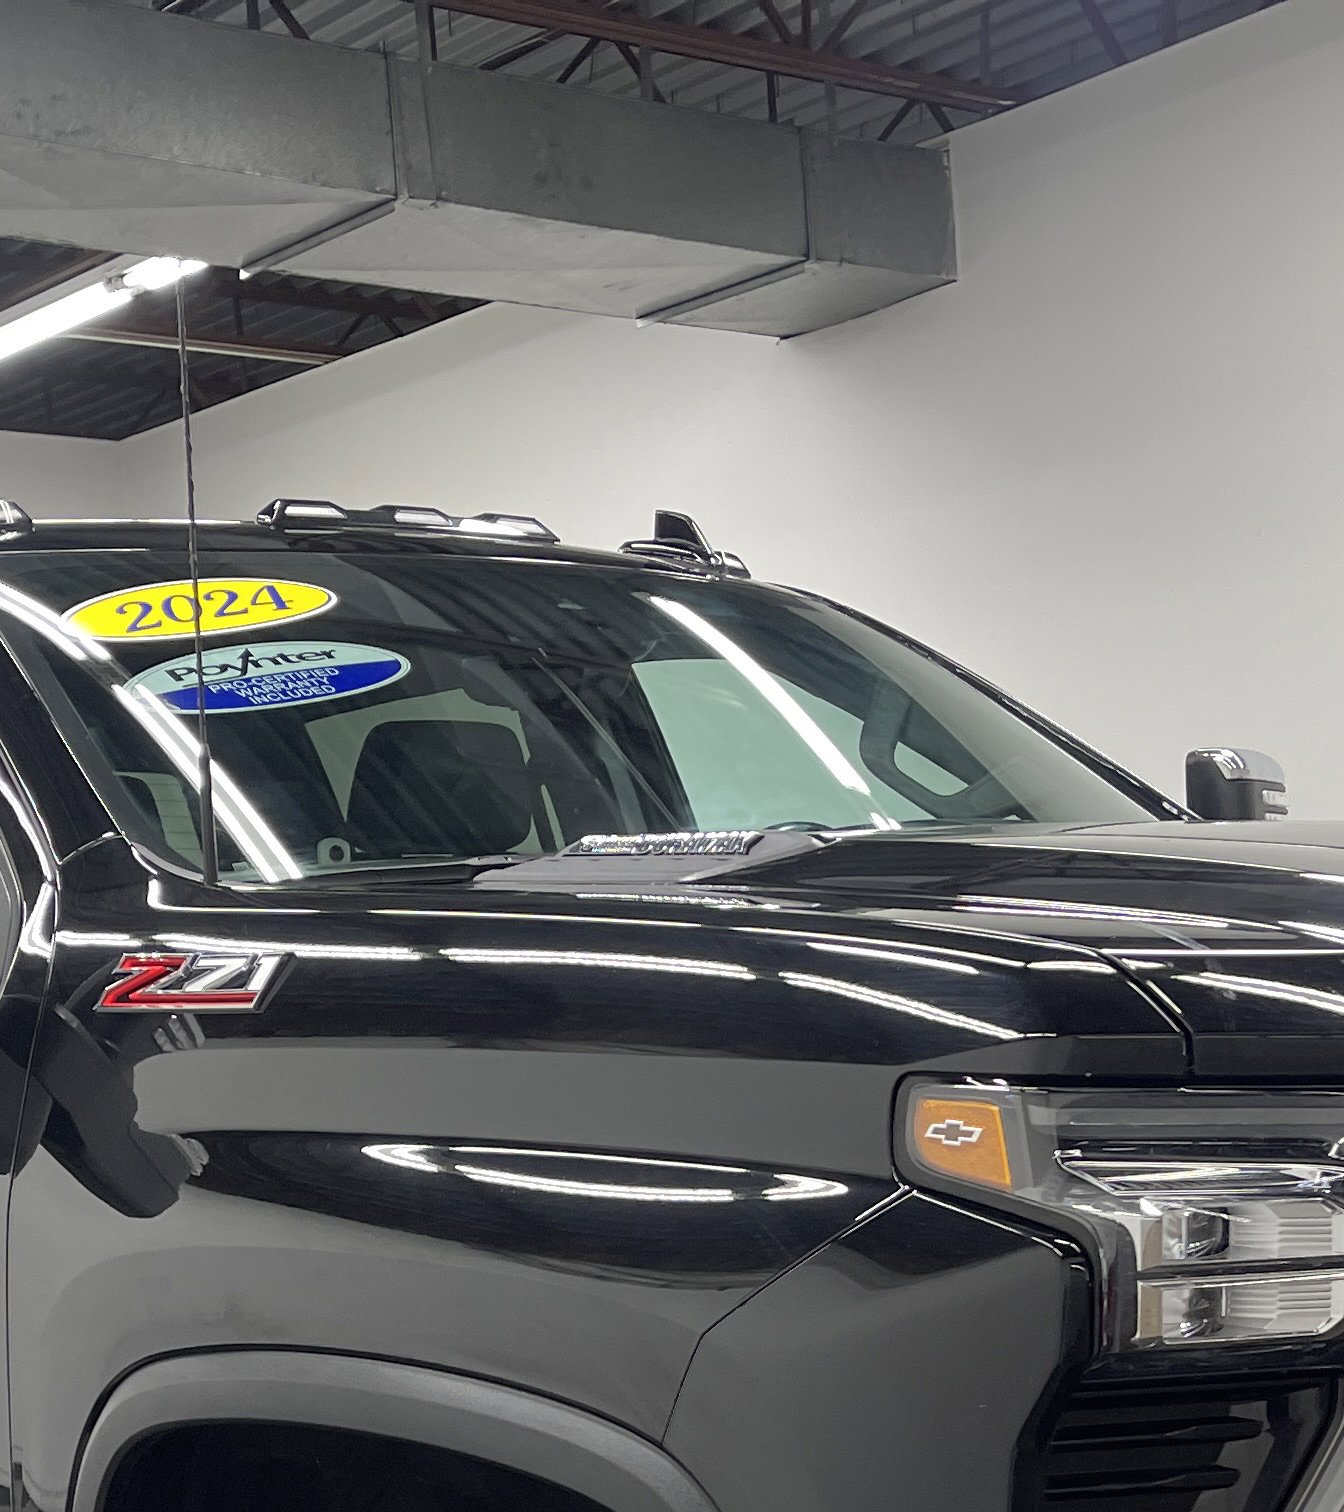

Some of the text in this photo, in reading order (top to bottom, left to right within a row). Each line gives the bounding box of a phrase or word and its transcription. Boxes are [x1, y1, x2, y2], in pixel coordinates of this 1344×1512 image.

[116, 585, 293, 633] 2024
[165, 648, 337, 684] Poynter
[207, 667, 340, 694] PRO-CERTIFIED
[235, 676, 331, 698] WARRANTY
[248, 685, 336, 705] INCLUDED
[93, 952, 291, 1013] Z71
